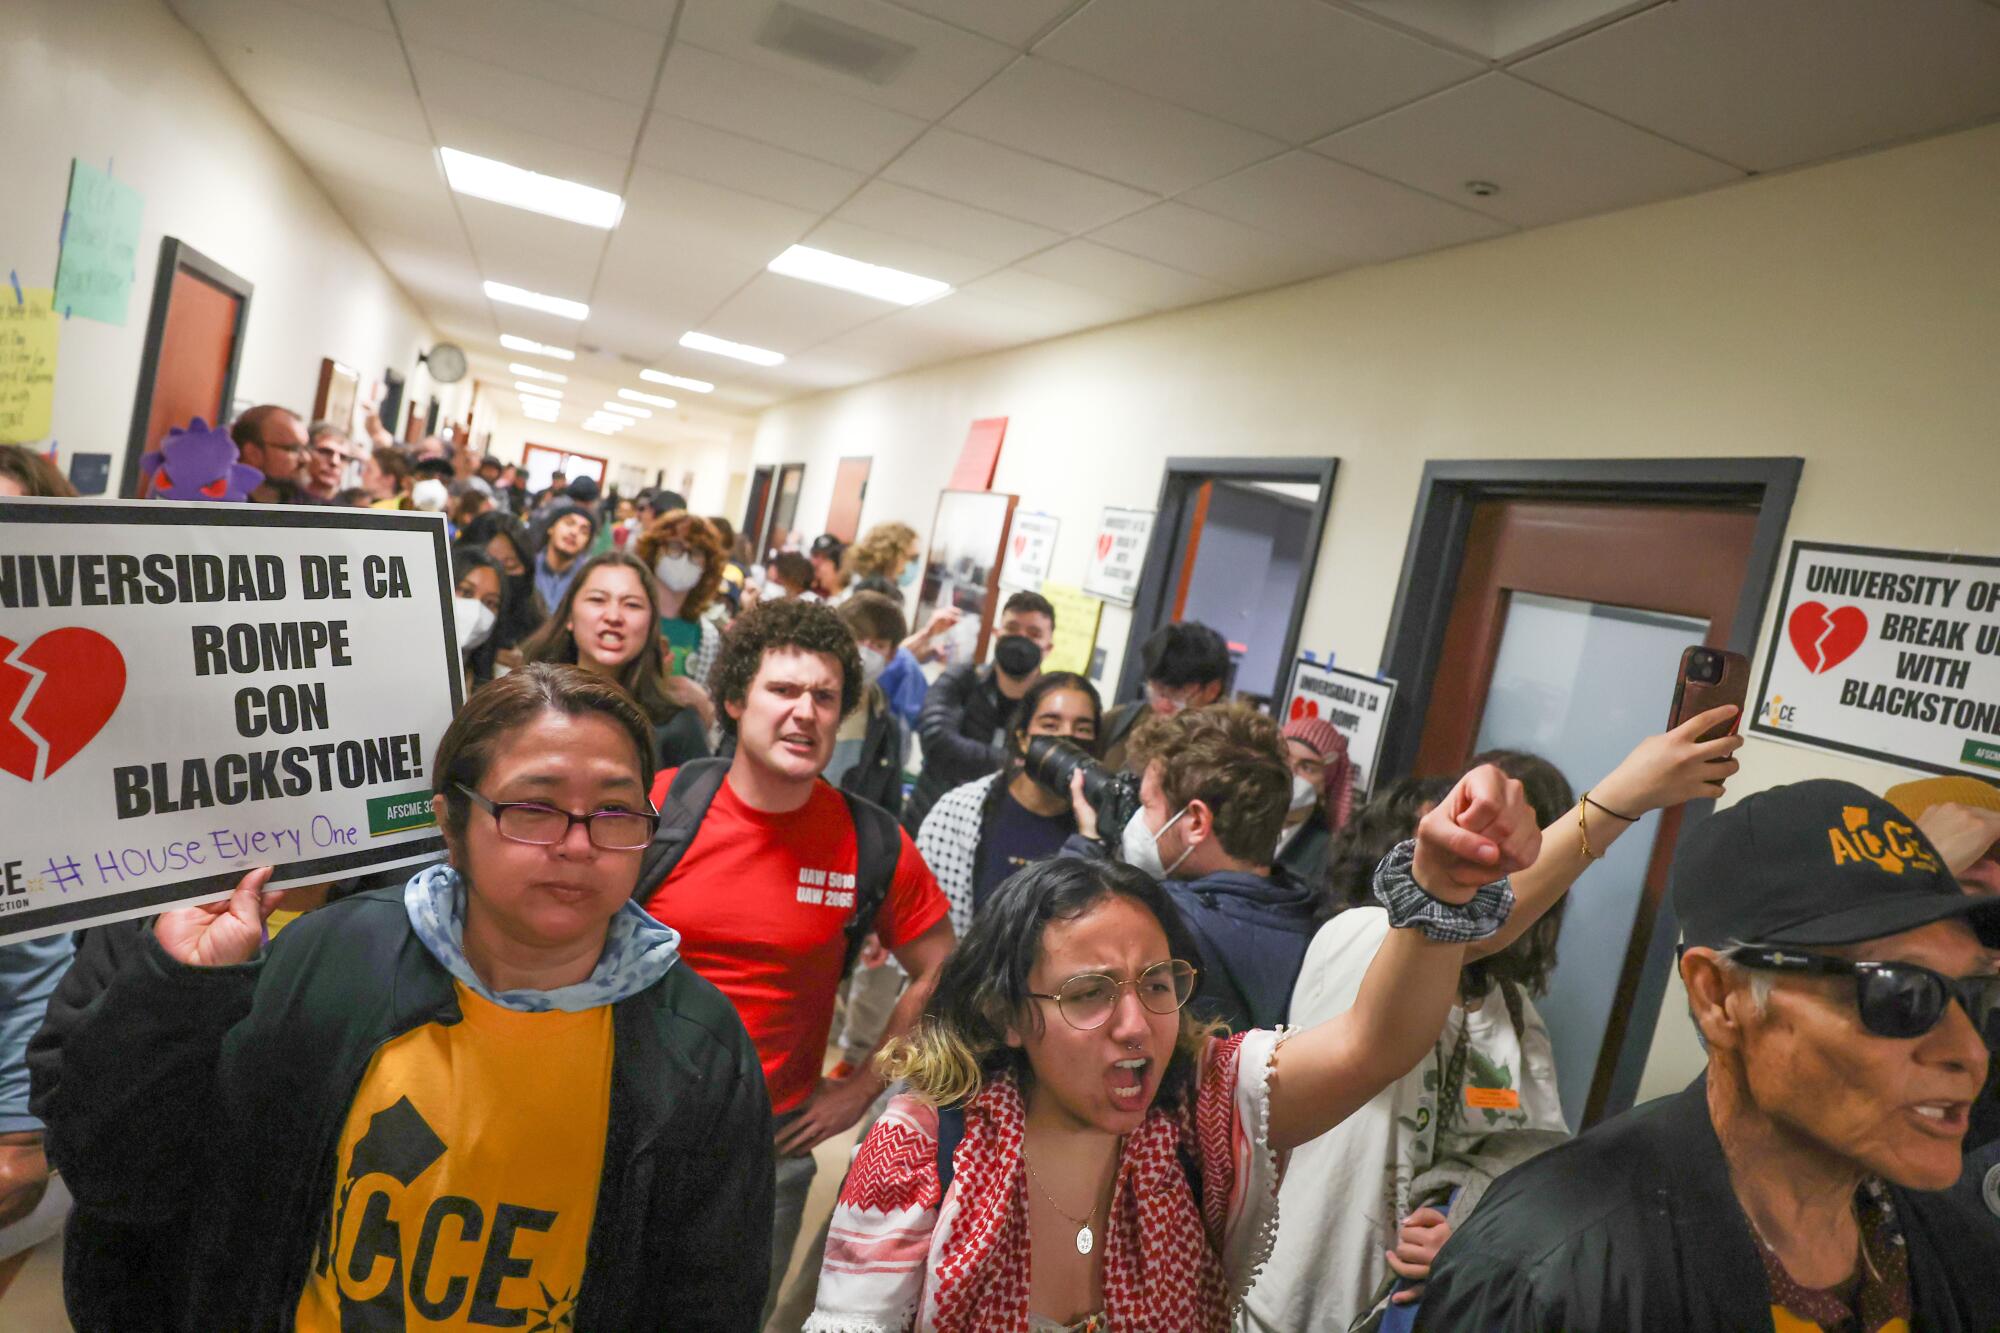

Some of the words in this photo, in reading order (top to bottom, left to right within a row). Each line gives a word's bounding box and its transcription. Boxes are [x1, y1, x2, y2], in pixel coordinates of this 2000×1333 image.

[300, 554, 351, 600] DE
[363, 555, 412, 599] CA
[1806, 565, 1960, 608] UNIVERSITY
[191, 620, 352, 676] ROMPE
[1880, 613, 1970, 652] BREAK
[1896, 651, 1971, 690] WITH
[234, 682, 329, 738] CON
[113, 733, 424, 820] BLACKSTONE!
[311, 814, 357, 847] One
[387, 802, 422, 820] AFSCME
[796, 886, 824, 905] UAW
[799, 867, 826, 886] UAW
